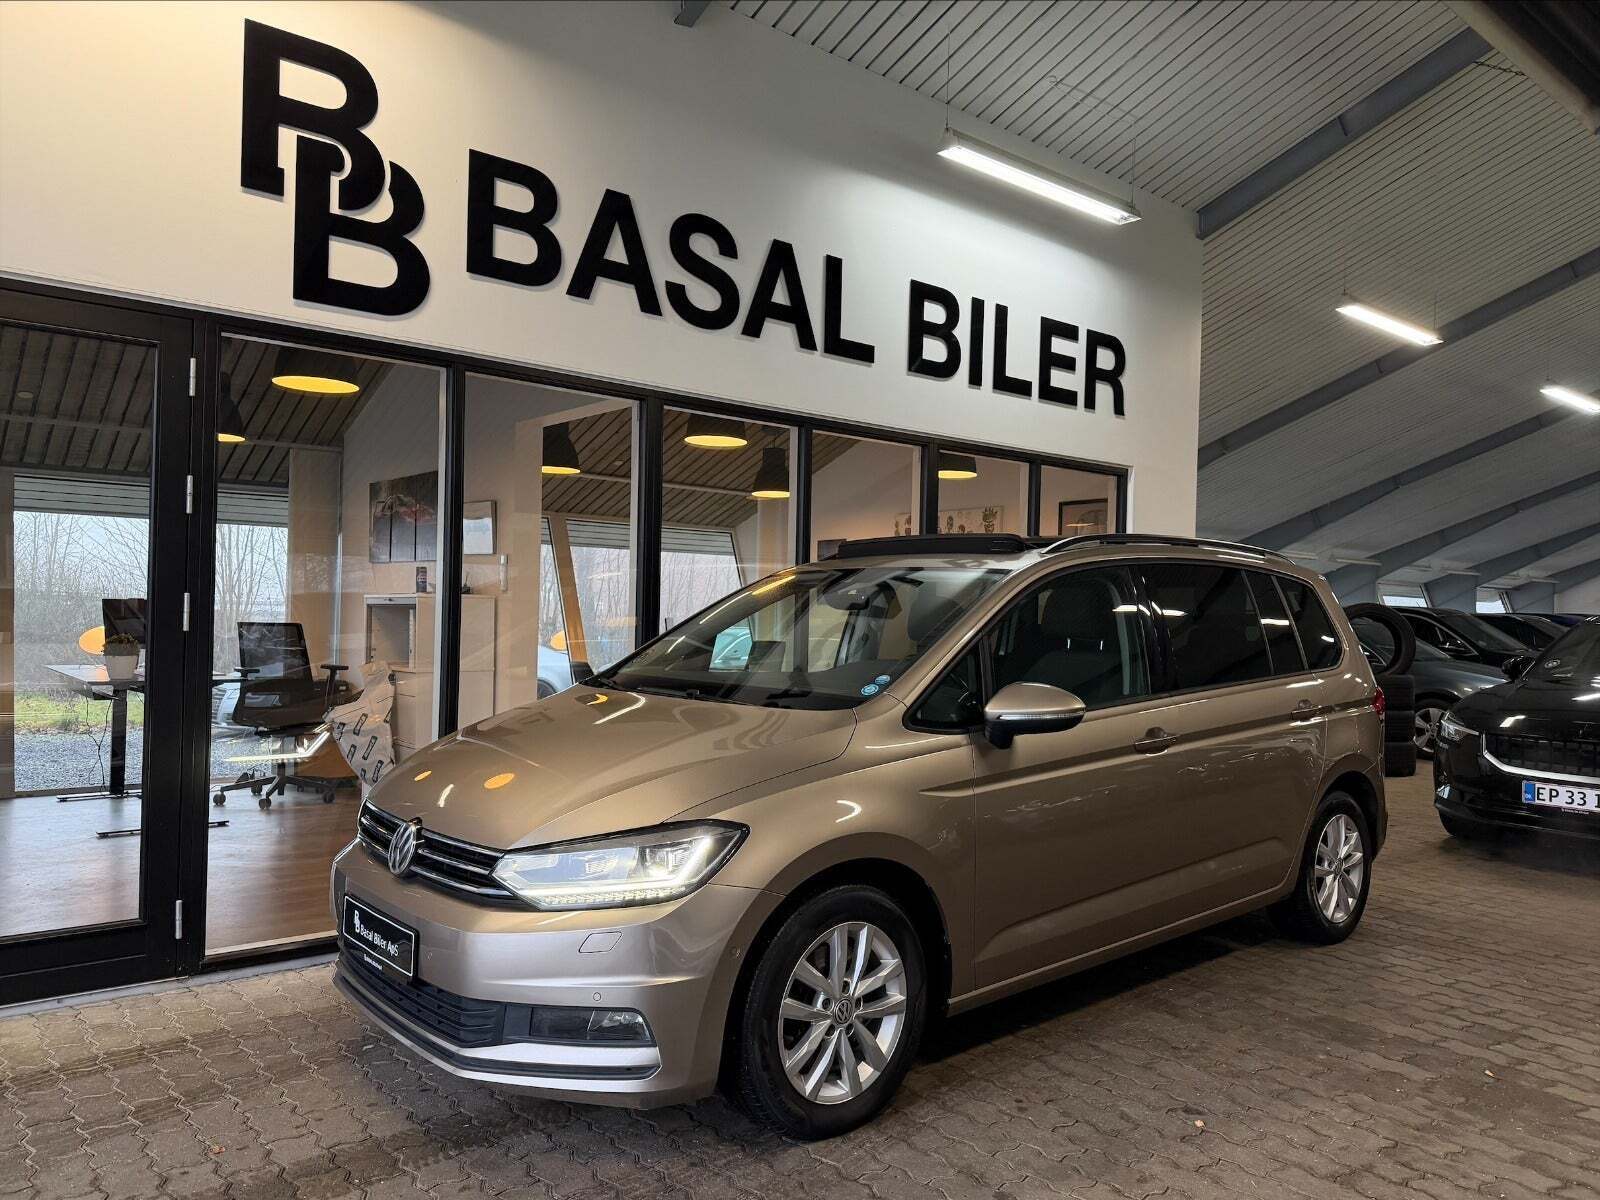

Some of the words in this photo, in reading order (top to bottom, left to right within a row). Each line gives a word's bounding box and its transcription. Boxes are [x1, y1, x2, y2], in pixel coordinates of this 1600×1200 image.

[467, 148, 875, 364] BASAL
[908, 279, 1127, 416] BILER
[1537, 787, 1559, 802] EP
[1565, 790, 1587, 806] 33
[360, 924, 374, 942] Basal
[373, 932, 387, 949] Biler
[387, 941, 399, 957] ApS
